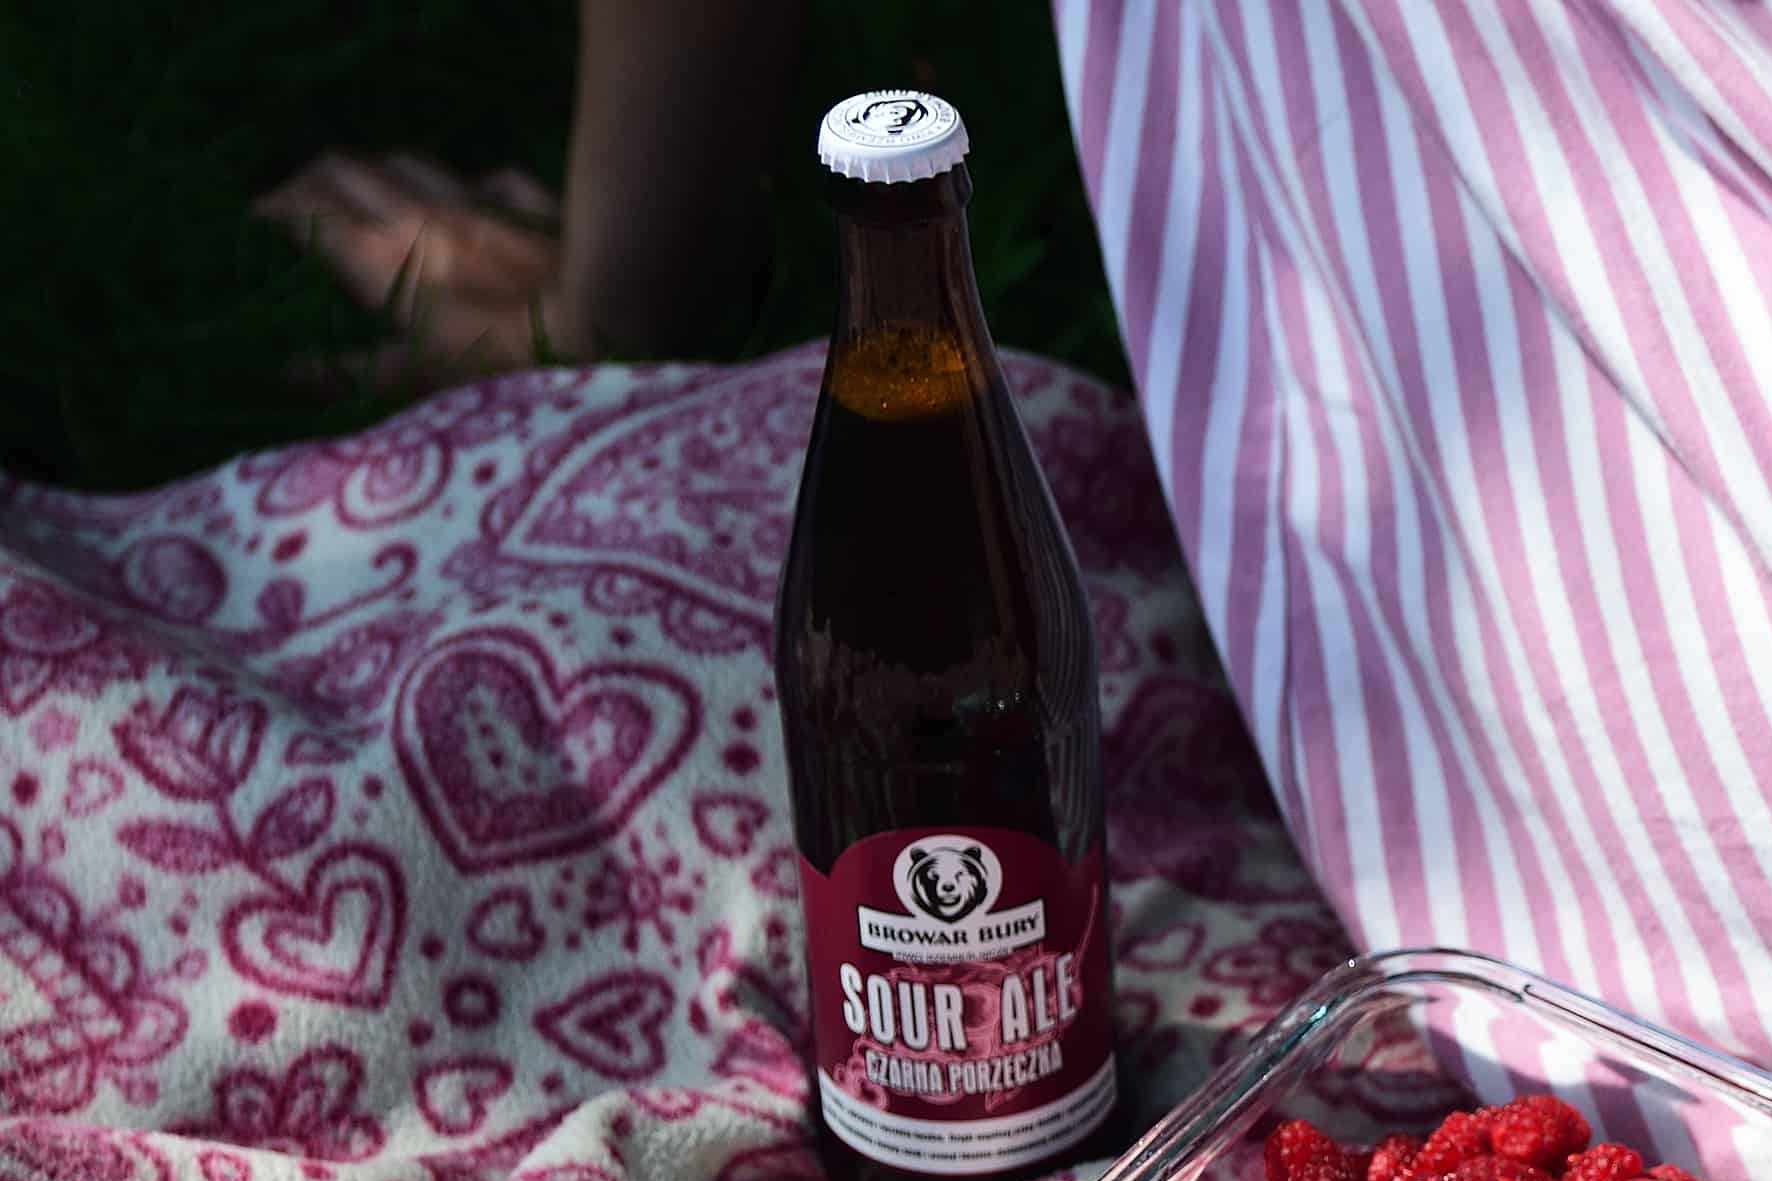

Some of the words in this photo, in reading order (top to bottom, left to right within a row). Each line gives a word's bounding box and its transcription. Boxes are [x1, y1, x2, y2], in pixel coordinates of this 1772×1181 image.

[867, 920, 969, 945] BROWAR
[978, 913, 1039, 943] BURY
[839, 963, 967, 1050] SOUR
[1000, 953, 1078, 1043] ALE
[865, 1050, 945, 1094] CZARNA
[950, 1042, 1063, 1094] PORZECZKA
